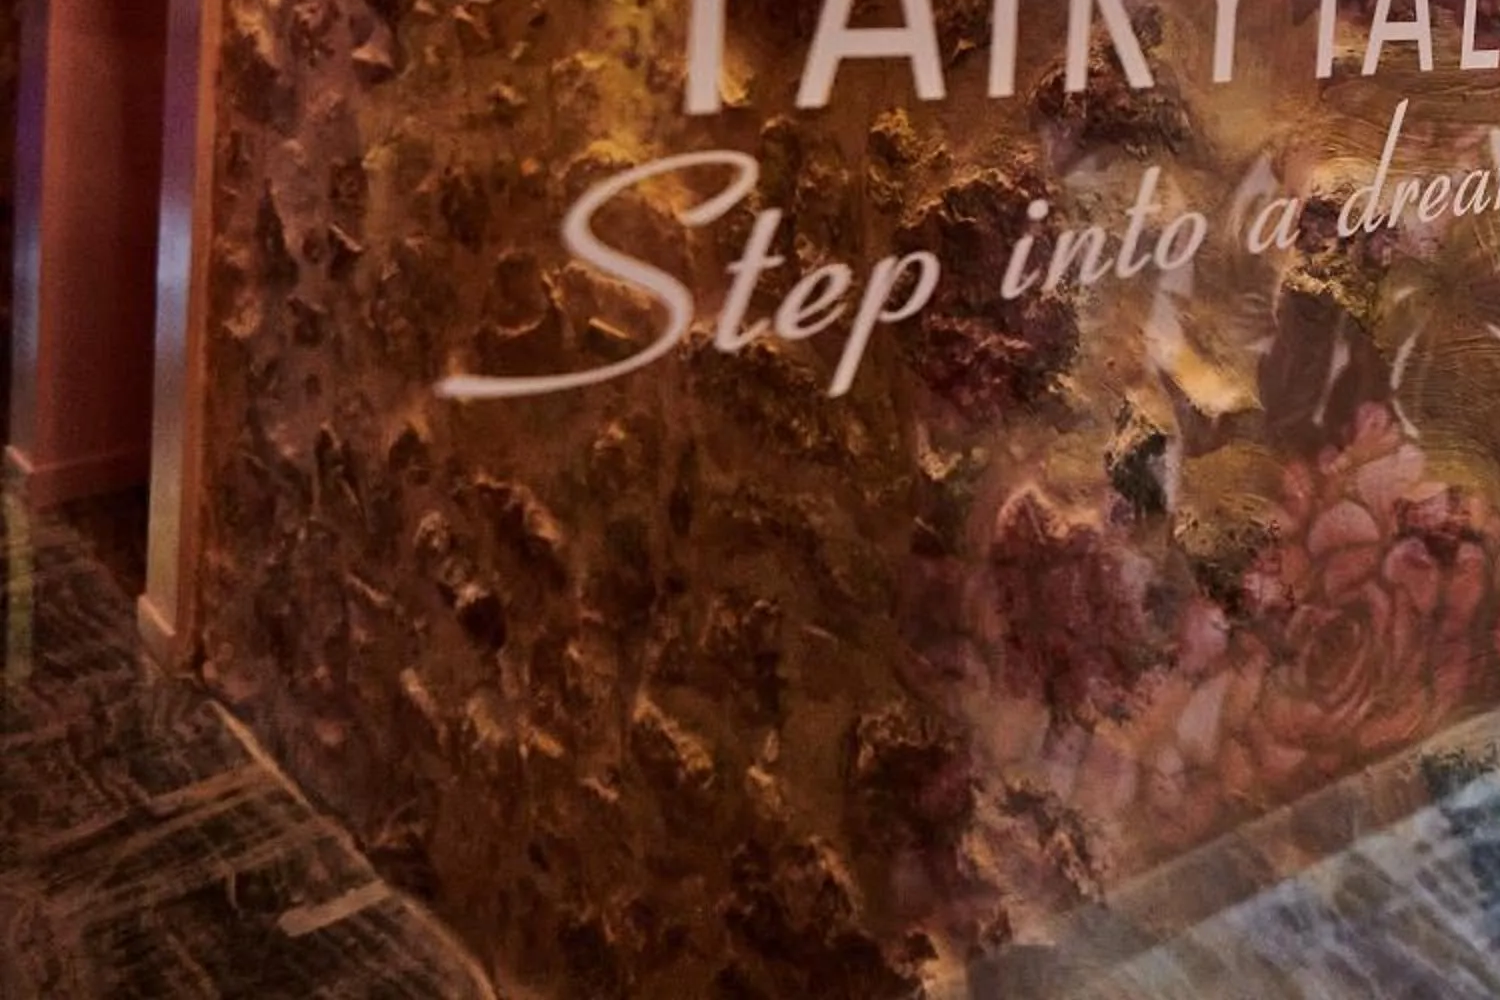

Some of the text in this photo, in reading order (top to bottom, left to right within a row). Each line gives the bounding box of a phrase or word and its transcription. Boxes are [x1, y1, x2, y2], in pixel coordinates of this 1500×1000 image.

[435, 149, 942, 400] Step
[1000, 164, 1206, 303] into
[1246, 193, 1300, 256] a
